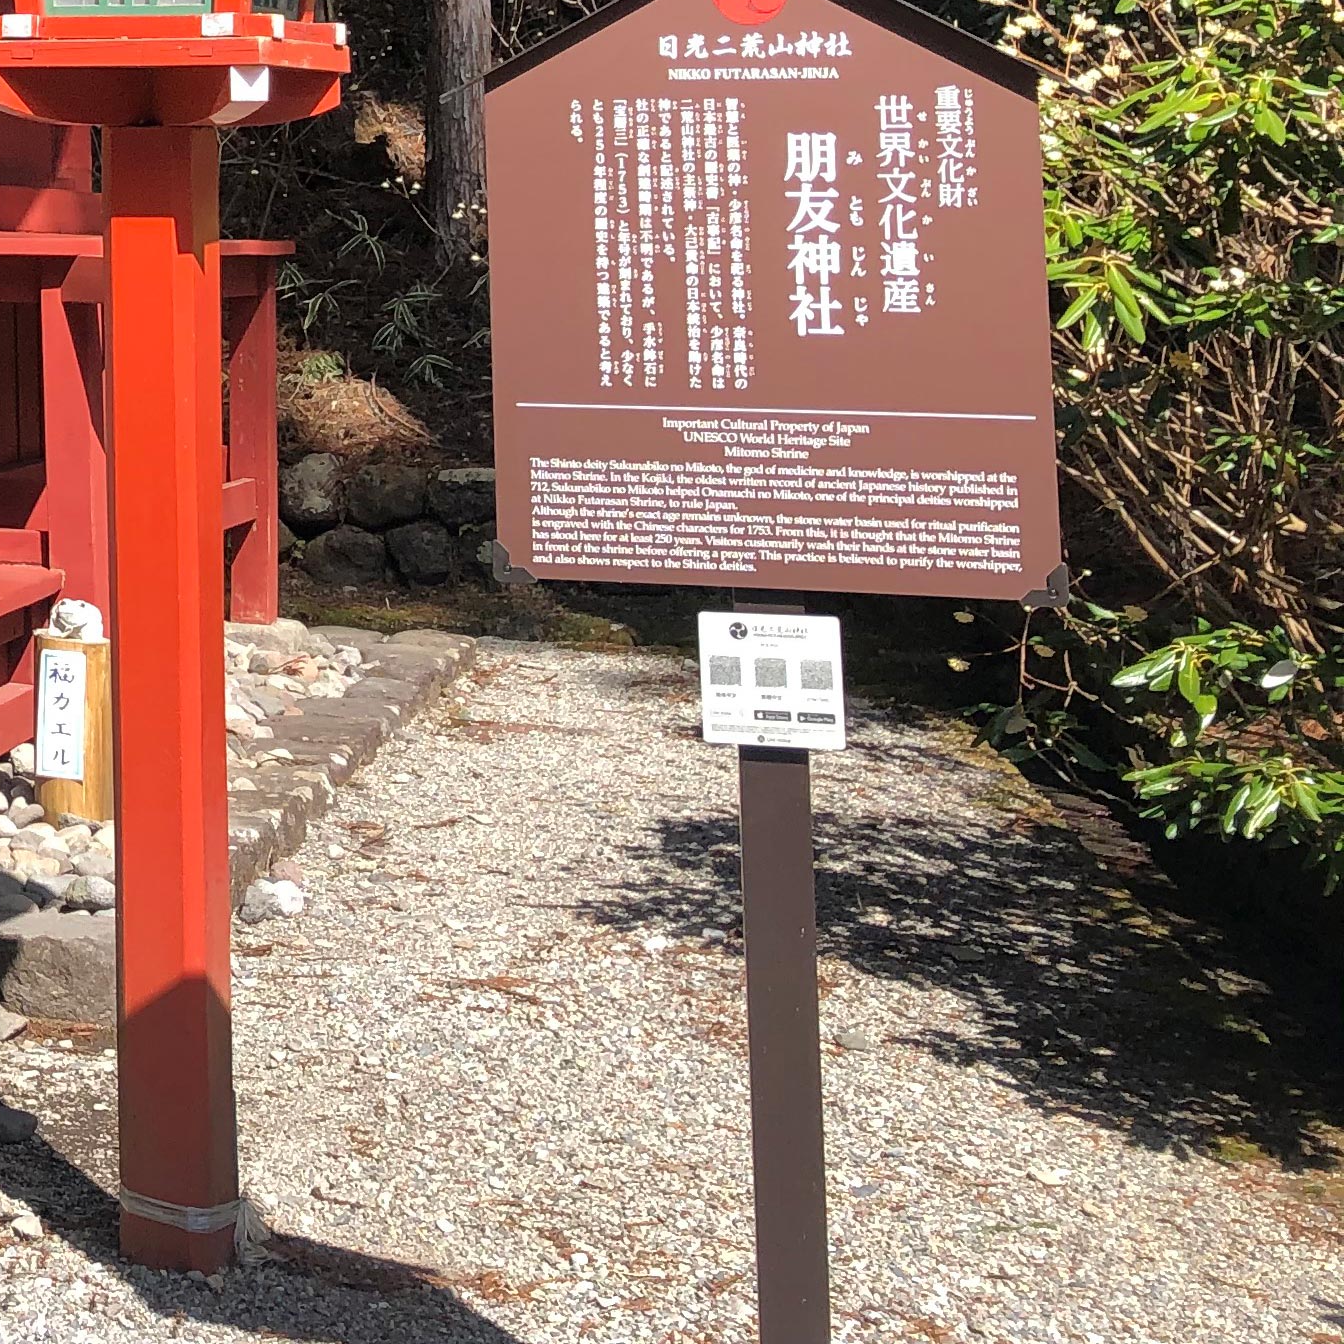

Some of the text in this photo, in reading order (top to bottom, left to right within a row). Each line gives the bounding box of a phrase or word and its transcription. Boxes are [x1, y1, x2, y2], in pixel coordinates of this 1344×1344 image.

[658, 30, 853, 60] 日光二荒山神社
[668, 66, 840, 81] NIKKO FUTARASAN-JINJA
[569, 98, 584, 143] られる。
[934, 84, 965, 208] 重要文化財
[874, 94, 922, 313] 世界文化遺産
[784, 131, 845, 337] 朋友神社
[662, 417, 869, 435] Important Cultural Property of Japan
[684, 431, 851, 448] UNESCO World Heritage Site
[724, 445, 809, 459] Mitomo Shrine
[530, 457, 549, 468] The
[550, 458, 583, 469] Shinto
[583, 459, 609, 472] deity
[609, 460, 669, 472] Sukunabiko
[670, 464, 684, 472] no
[726, 463, 743, 474] the
[744, 464, 763, 477] god
[765, 464, 776, 475] of
[778, 465, 825, 477] medicine
[826, 466, 847, 477] and
[910, 469, 920, 479] is
[920, 469, 985, 483] worshipped
[986, 471, 998, 482] at
[999, 471, 1017, 482] the
[531, 469, 571, 481] Mitomo
[610, 472, 621, 482] In
[623, 472, 640, 483] the
[676, 474, 693, 485] the
[695, 474, 727, 486] oldest
[728, 475, 767, 487] written
[768, 476, 803, 488] record
[804, 478, 815, 488] of
[818, 478, 857, 490] ancient
[858, 479, 907, 493] Japanese
[908, 481, 947, 494] history
[948, 482, 1004, 496] published
[1006, 484, 1018, 495] in
[531, 493, 541, 504] at
[544, 494, 576, 505] Nikko
[578, 495, 629, 507] Futarasan
[668, 498, 680, 509] to
[682, 498, 703, 509] rule
[551, 482, 611, 494] Sukunabiko
[612, 486, 627, 495] no
[628, 484, 665, 496] Mikoto
[666, 486, 700, 499] helped
[701, 487, 756, 499] Onamuchi
[757, 491, 772, 499] no
[814, 493, 835, 501] one
[836, 491, 847, 502] of
[849, 491, 867, 502] the
[867, 492, 915, 506] principal
[916, 494, 952, 505] deities
[953, 495, 1019, 509] worshipped
[532, 505, 579, 519] Although
[580, 507, 595, 518] the
[635, 509, 661, 520] exact
[662, 512, 681, 523] age
[682, 510, 722, 522] remains
[776, 514, 793, 525] the
[794, 514, 822, 526] stone
[823, 515, 853, 527] water
[854, 516, 883, 528] basin
[884, 517, 909, 529] used
[910, 518, 927, 529] for
[928, 519, 957, 530] ritual
[958, 520, 1020, 534] purification
[532, 517, 541, 527] is
[542, 517, 589, 531] engraved
[590, 519, 615, 530] with
[616, 520, 633, 531] the
[634, 520, 675, 532] Chinese
[676, 522, 729, 534] characters
[730, 524, 745, 535] for
[776, 525, 804, 537] From
[830, 527, 838, 538] it
[840, 527, 849, 538] is
[850, 528, 893, 542] thought
[895, 529, 917, 541] that
[918, 530, 937, 541] the
[938, 531, 983, 543] Mitomo
[983, 533, 1020, 544] Shrine
[532, 528, 550, 540] has
[550, 529, 578, 541] stood
[580, 530, 601, 541] here
[602, 531, 618, 542] for
[619, 532, 629, 542] at
[630, 532, 653, 543] least
[654, 533, 673, 544] 250
[704, 535, 743, 547] Visitors
[744, 536, 805, 551] customarily
[806, 539, 835, 550] wash
[836, 540, 861, 551] their
[862, 541, 895, 552] hands
[896, 542, 907, 553] at
[908, 542, 927, 554] the
[927, 543, 957, 555] stone
[958, 544, 990, 556] water
[990, 545, 1020, 557] basin
[532, 540, 543, 551] in
[544, 541, 569, 552] front
[571, 542, 582, 553] of
[584, 542, 601, 553] the
[602, 543, 634, 555] shrine
[635, 544, 668, 556] before
[669, 546, 711, 560] offering
[712, 550, 719, 558] a
[758, 549, 783, 561] This
[784, 550, 826, 565] practice
[828, 552, 837, 563] is
[838, 553, 884, 565] believed
[886, 555, 898, 565] to
[899, 555, 934, 569] purify
[936, 557, 954, 568] the
[532, 552, 553, 563] and
[554, 553, 576, 564] also
[577, 554, 611, 565] shows
[612, 555, 649, 569] respect
[651, 556, 663, 567] to
[664, 557, 681, 568] the
[682, 557, 717, 569] Shinto
[48, 662, 75, 766] 福カエル
